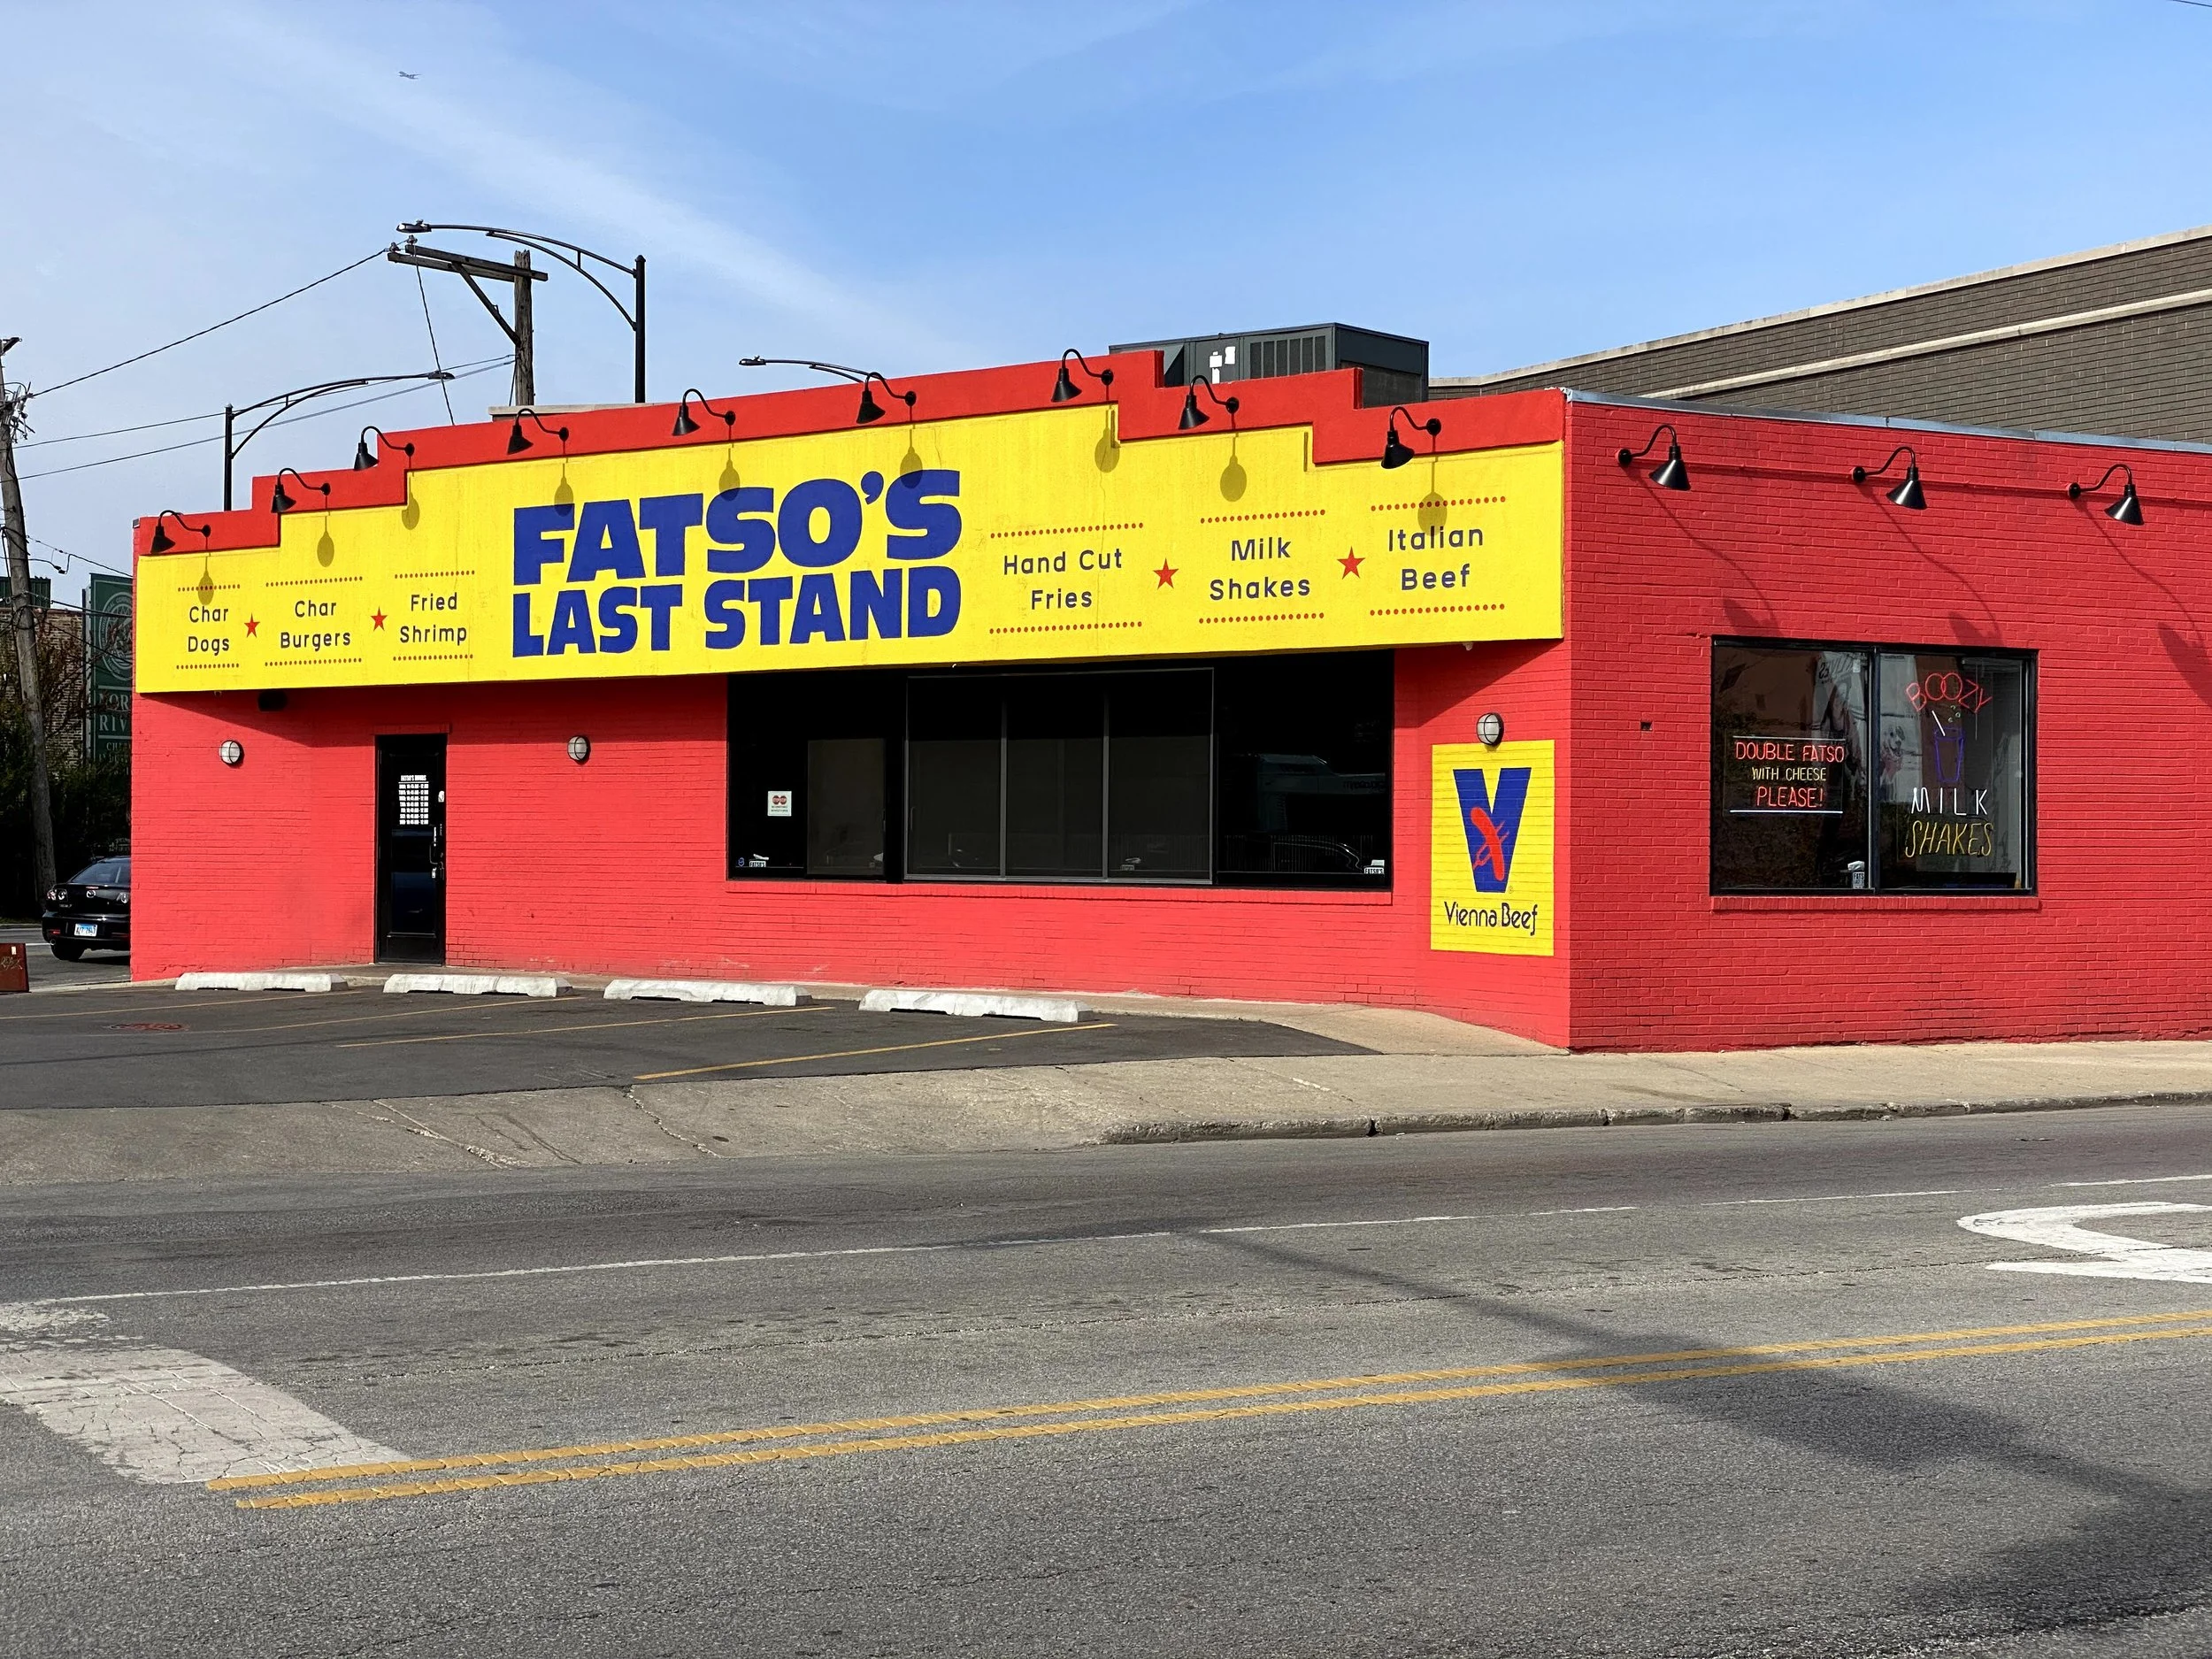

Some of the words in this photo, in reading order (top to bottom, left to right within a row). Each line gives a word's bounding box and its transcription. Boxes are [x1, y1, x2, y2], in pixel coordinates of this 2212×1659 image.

[514, 470, 961, 585] FATSO'S
[1389, 526, 1483, 552] Italian
[1232, 537, 1291, 562] Milk
[1004, 551, 1066, 575] Hand
[1079, 548, 1122, 571] Cut
[1210, 576, 1310, 601] Shakes
[1402, 563, 1471, 591] Beef
[295, 600, 336, 618] Char
[411, 593, 457, 611] Fried
[1032, 588, 1093, 610] Fries
[189, 606, 229, 623] Char
[513, 584, 682, 657] LAST
[704, 566, 961, 649] STAND
[188, 636, 230, 656] Dogs
[280, 632, 350, 651] Burgers
[400, 625, 467, 646] Shrimp
[1906, 672, 1993, 713] BOOZY
[99, 714, 127, 733] RIV
[1735, 741, 1795, 761] DOUBLE
[1802, 744, 1845, 763] FATSO
[1752, 766, 1779, 780] WITH
[1786, 767, 1827, 781] CHEESE
[1756, 786, 1824, 808] PLEASE!
[1911, 787, 1988, 816] MILK
[1905, 820, 1994, 858] SHAKES
[1443, 901, 1498, 928] Vienna
[1501, 902, 1538, 936] Beef
